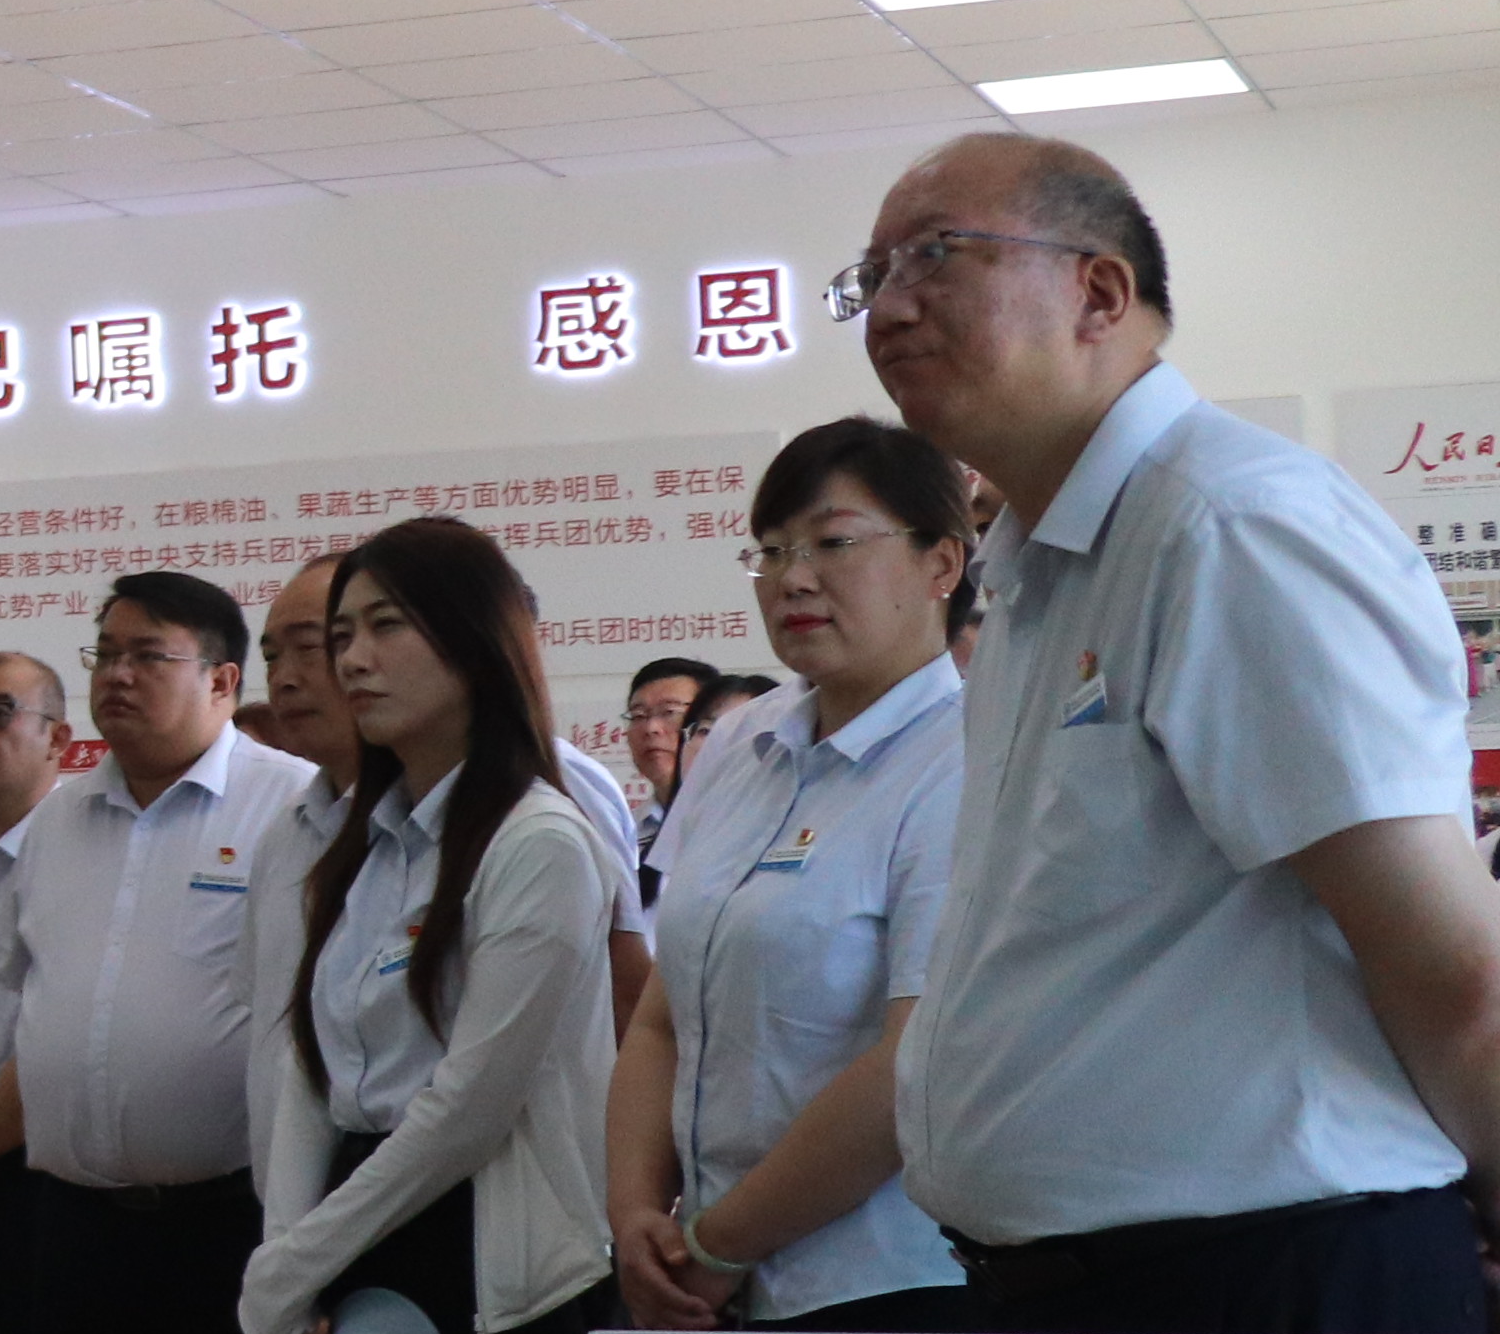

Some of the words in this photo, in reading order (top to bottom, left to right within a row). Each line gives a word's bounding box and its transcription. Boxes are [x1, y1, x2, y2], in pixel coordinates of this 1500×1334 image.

[533, 268, 794, 374] 感恩
[1383, 422, 1500, 474] 人民日
